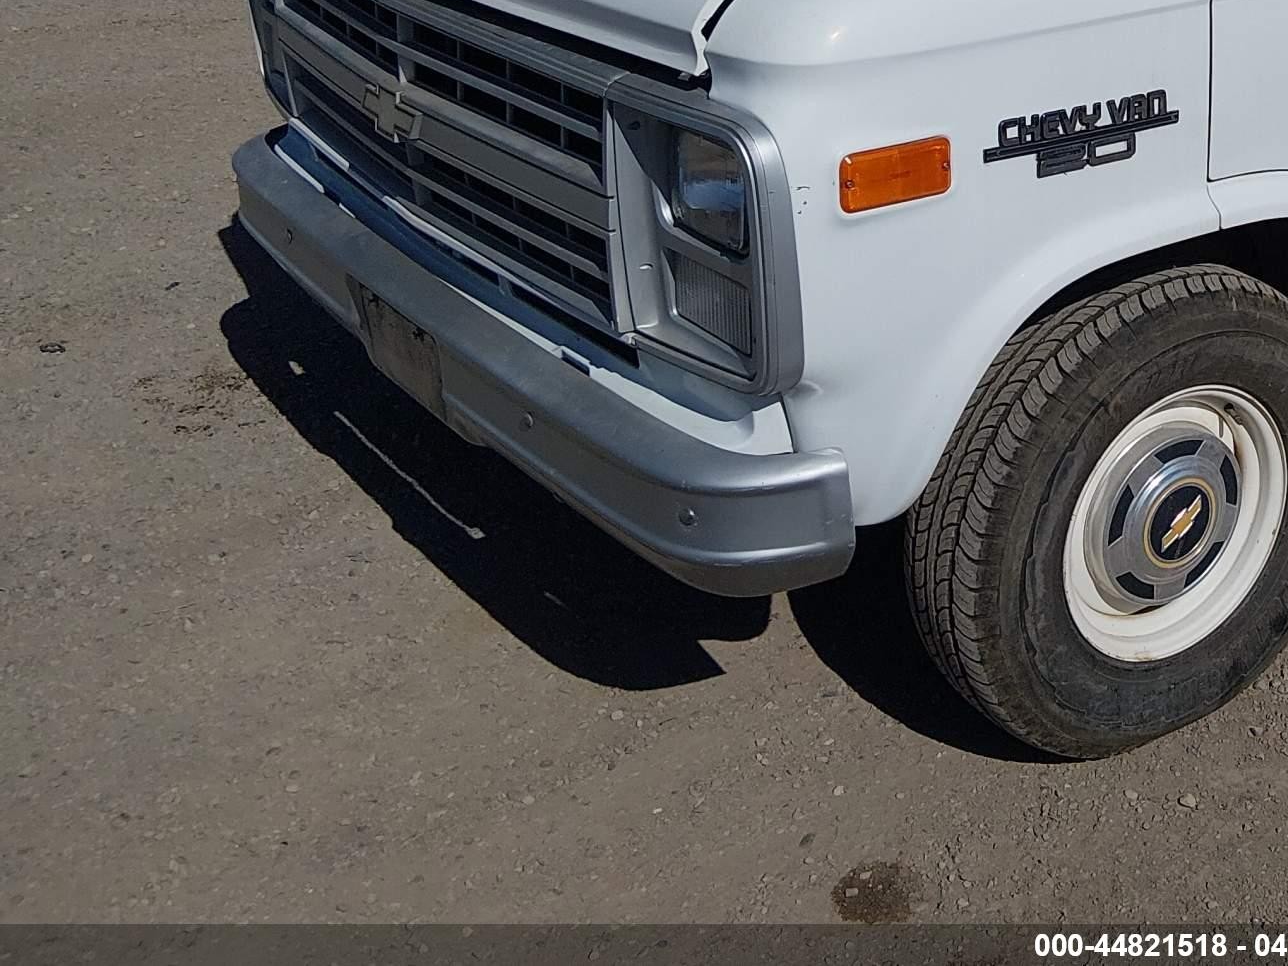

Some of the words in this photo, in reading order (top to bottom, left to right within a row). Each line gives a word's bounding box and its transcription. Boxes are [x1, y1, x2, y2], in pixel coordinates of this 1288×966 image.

[997, 101, 1102, 147] CHEVY
[1105, 88, 1168, 125] VAN
[1035, 132, 1137, 179] 20
